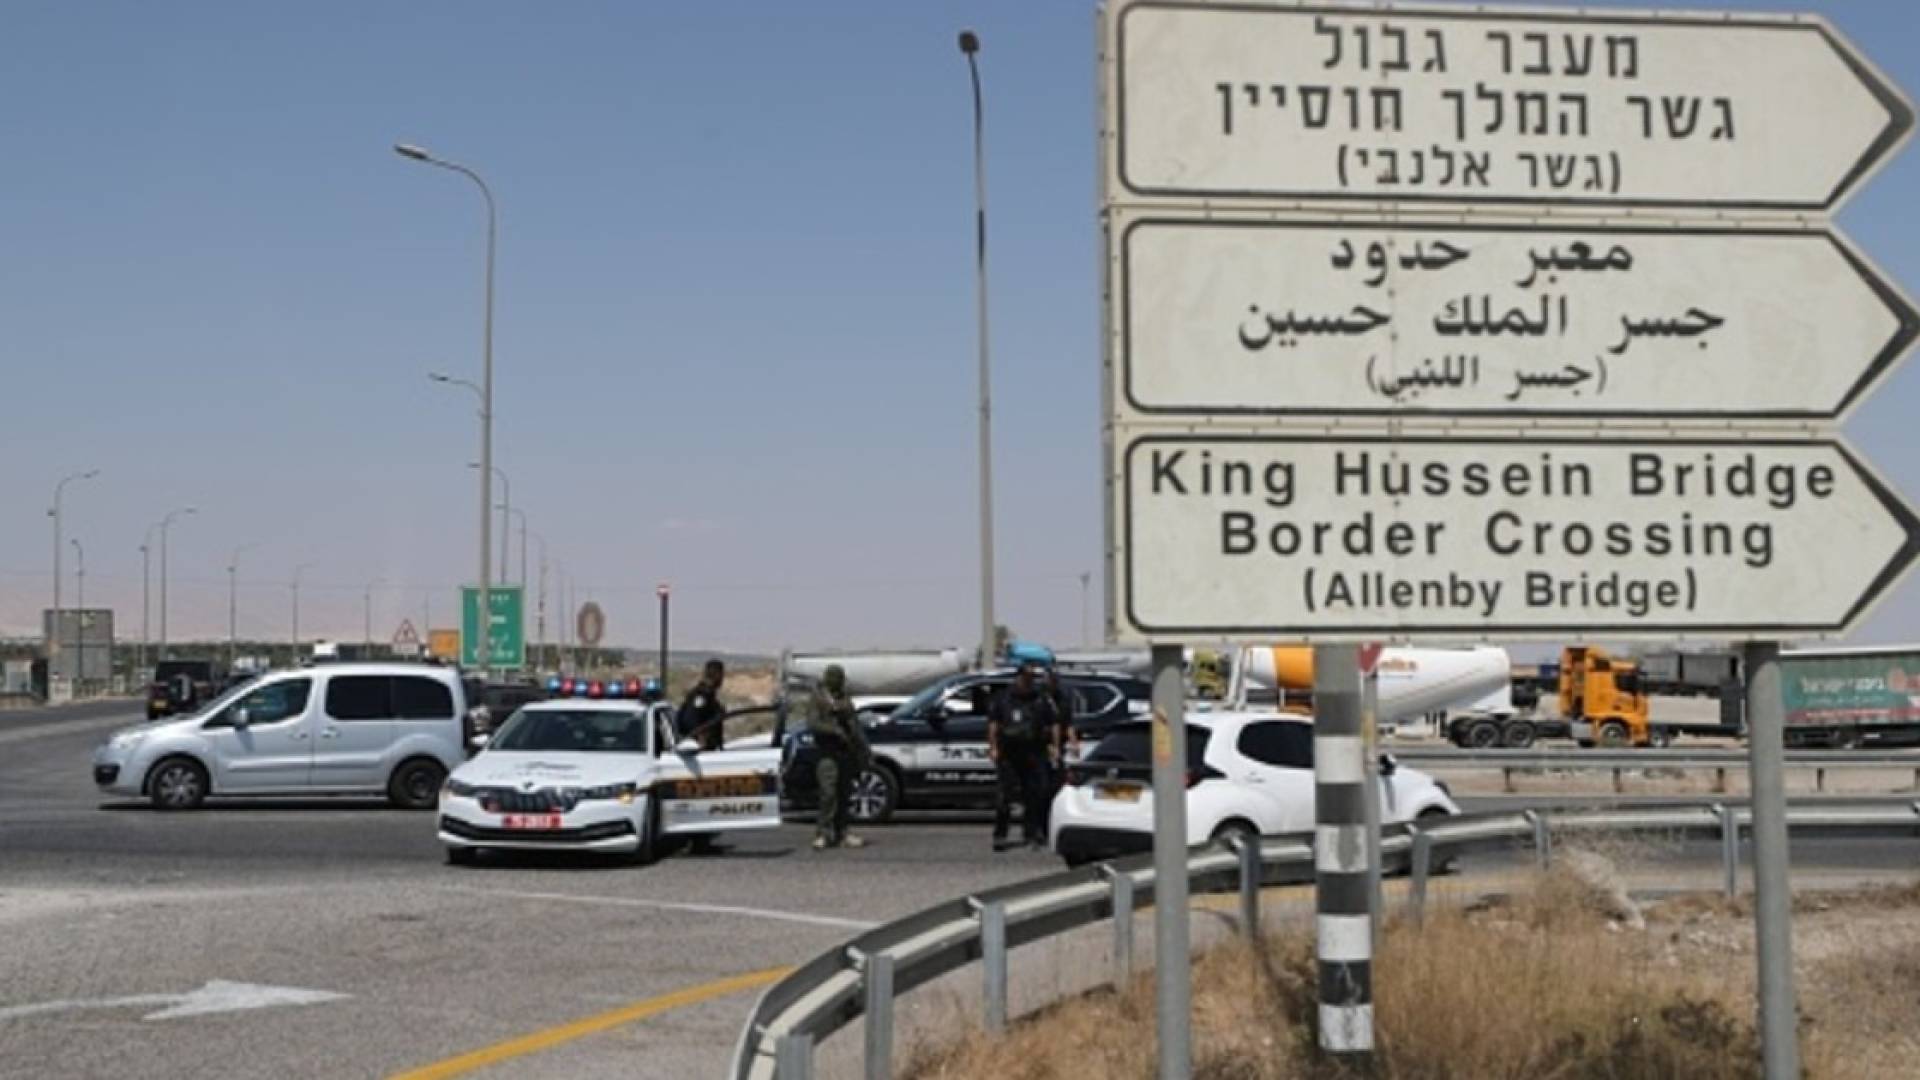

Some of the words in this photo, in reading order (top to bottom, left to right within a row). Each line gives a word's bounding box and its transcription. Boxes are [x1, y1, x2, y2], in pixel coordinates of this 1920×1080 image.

[1313, 16, 1448, 74] גבול
[1486, 31, 1639, 79] מעבר
[1215, 83, 1403, 135] חוסיין
[1441, 82, 1589, 142] המלך
[1626, 95, 1736, 141] גשר
[1337, 144, 1490, 187] אלנבי)
[1517, 151, 1622, 194] (גשר
[1330, 238, 1470, 287] حدود
[1515, 240, 1634, 288] معبر
[1237, 305, 1392, 351] حسين
[1433, 294, 1567, 338] الملك
[1608, 308, 1726, 355] جسر
[1365, 354, 1480, 401] اللنبي)
[1505, 355, 1607, 400] (جسر
[1150, 449, 1295, 507] King
[1334, 451, 1591, 498] Hussein
[1629, 452, 1836, 507] Bridge
[1220, 510, 1446, 558] Border
[1485, 510, 1776, 567] Crossing
[1303, 567, 1502, 615] (Allenby
[1524, 566, 1699, 614] Bridge)
